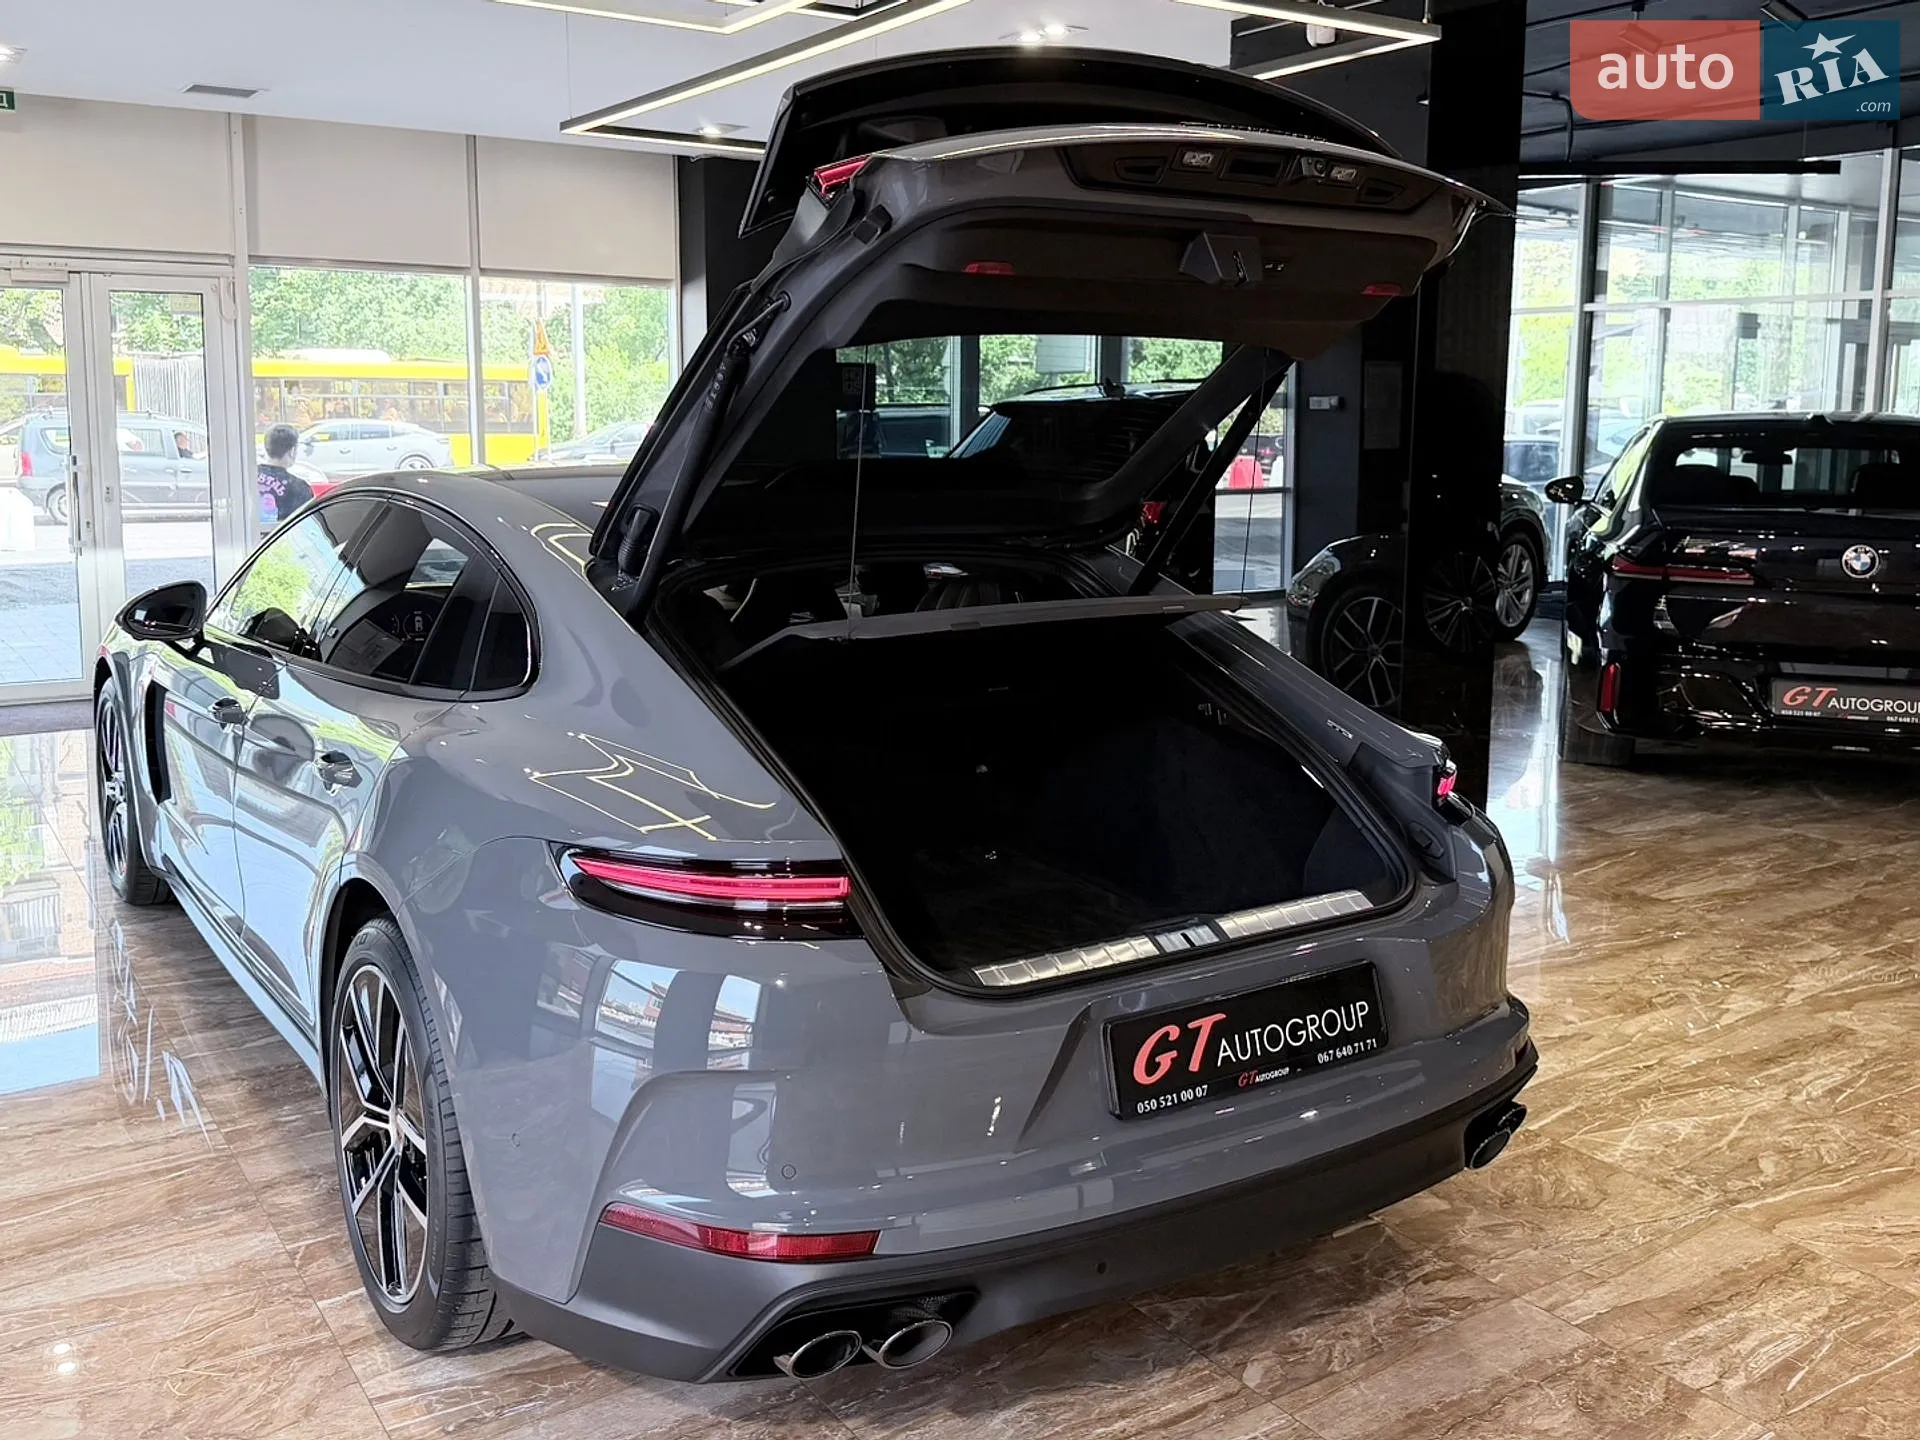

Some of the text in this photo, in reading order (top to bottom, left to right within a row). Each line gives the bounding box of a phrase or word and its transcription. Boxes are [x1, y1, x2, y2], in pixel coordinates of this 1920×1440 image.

[1782, 685, 1920, 714] GT AUTOGROU
[1132, 1000, 1370, 1086] GT AUTOGROUP
[1317, 1038, 1378, 1064] 067 640 71 71
[1136, 1084, 1208, 1114] 050 521 00 07
